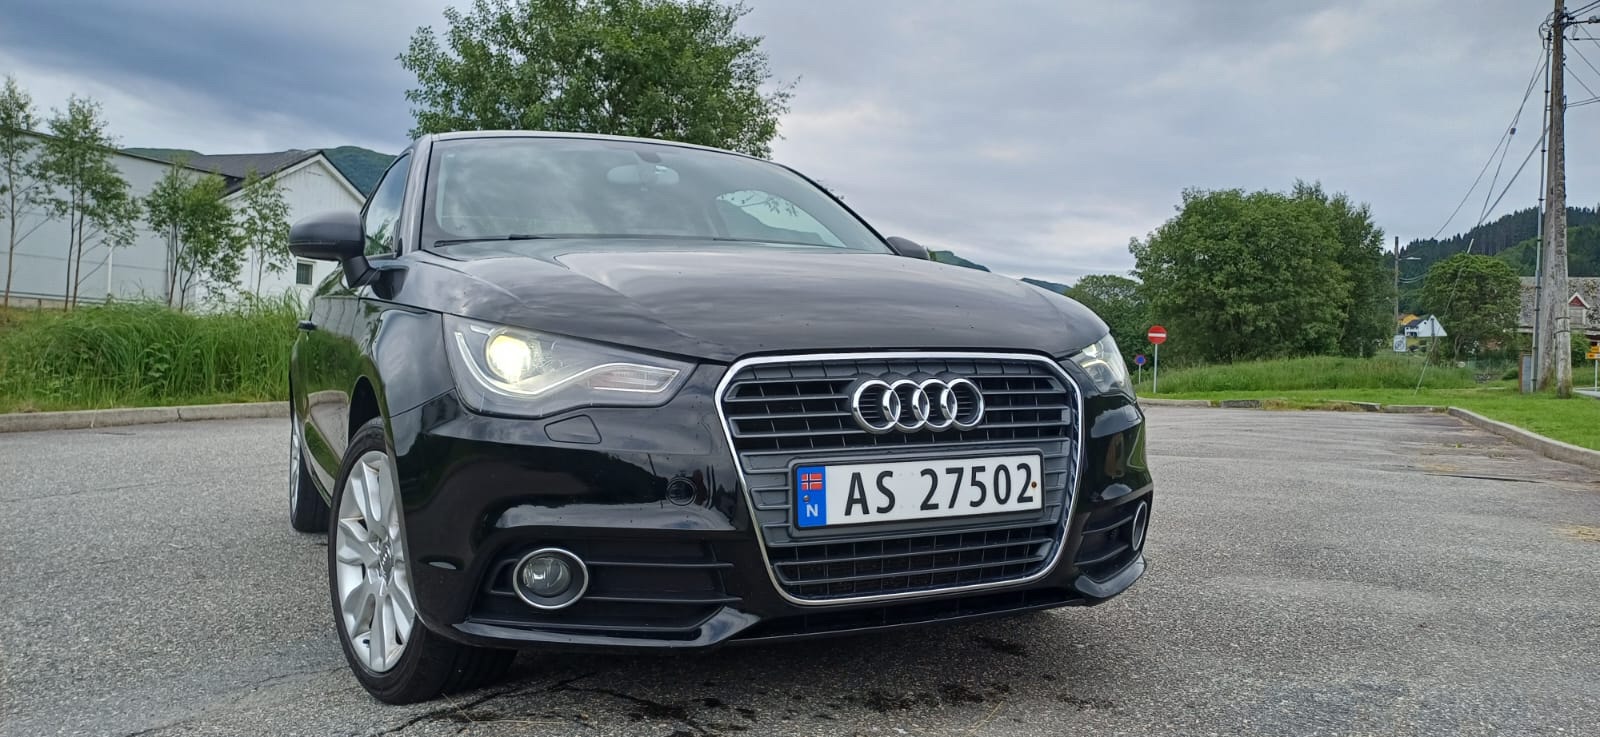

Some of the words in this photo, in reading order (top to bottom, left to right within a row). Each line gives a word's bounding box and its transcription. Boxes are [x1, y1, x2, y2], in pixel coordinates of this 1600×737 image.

[844, 471, 896, 517] AS
[919, 463, 1034, 511] 27502
[806, 503, 819, 517] N
